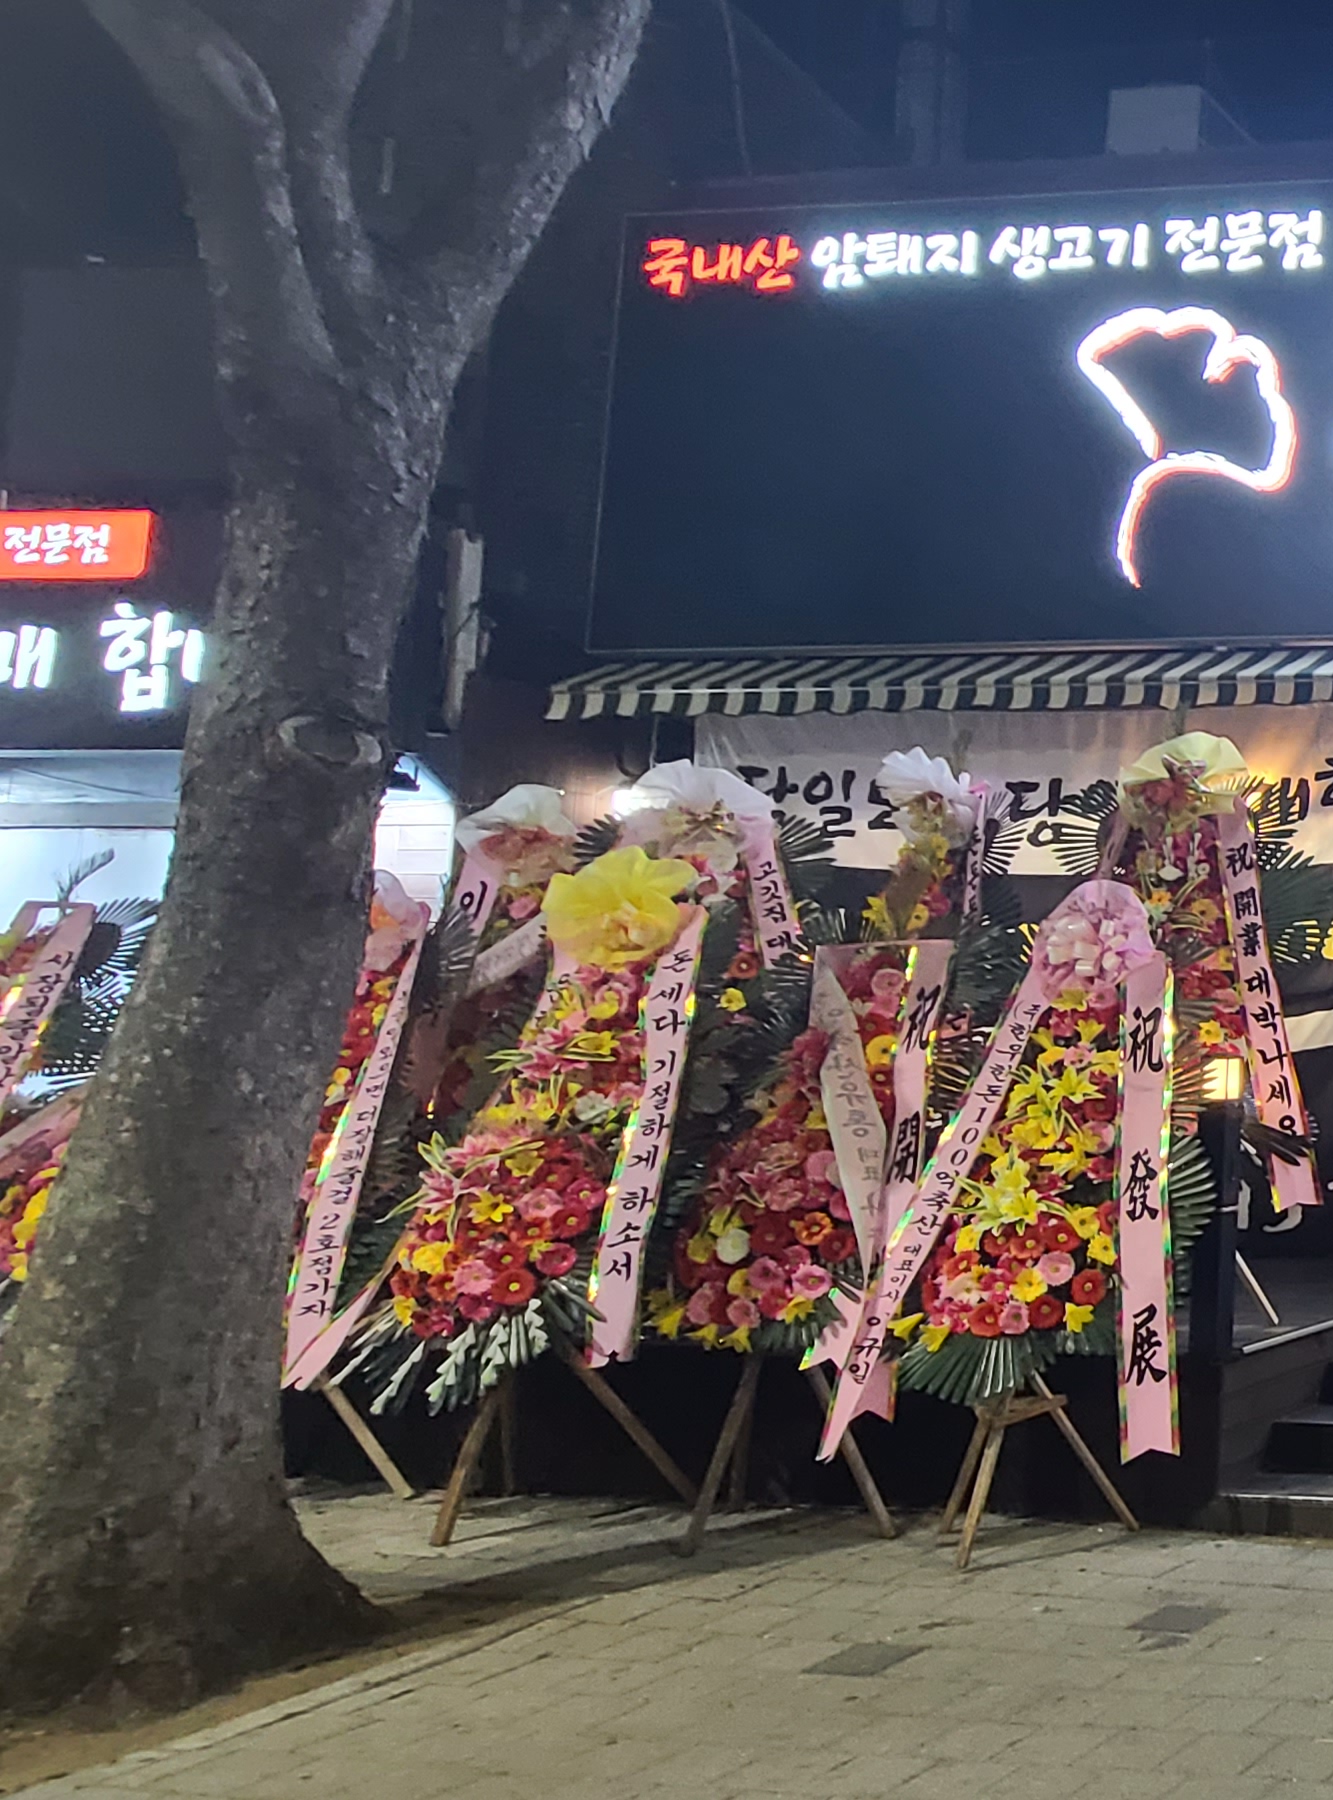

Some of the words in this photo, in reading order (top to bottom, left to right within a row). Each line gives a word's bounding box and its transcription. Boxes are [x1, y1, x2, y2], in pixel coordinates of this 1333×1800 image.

[643, 234, 799, 297] 국내산
[810, 228, 977, 289] 암퇘지
[988, 221, 1150, 280] 생고기
[1164, 208, 1325, 273] 전문점
[4, 523, 110, 564] 전문점
[753, 861, 787, 923] 고깃집
[604, 1184, 655, 1282] 하소서
